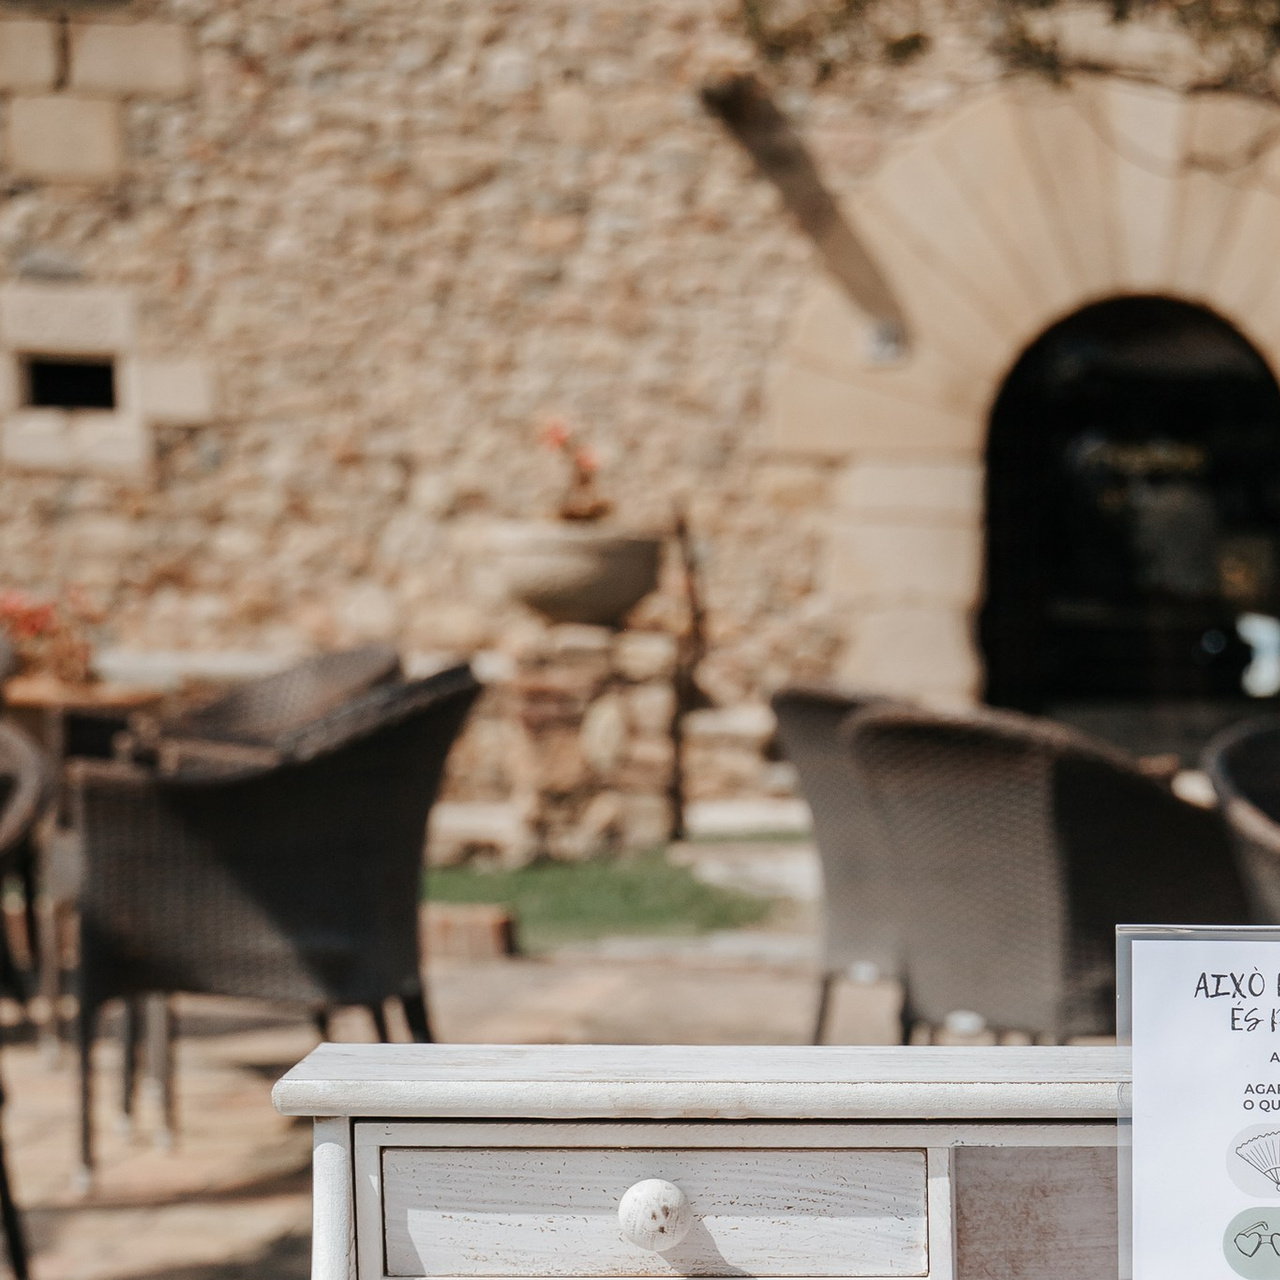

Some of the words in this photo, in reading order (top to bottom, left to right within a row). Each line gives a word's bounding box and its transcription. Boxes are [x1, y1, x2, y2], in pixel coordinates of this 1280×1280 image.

[1194, 966, 1265, 999] AIXÒ
[1231, 1001, 1264, 1032] ÉS
[1243, 1100, 1254, 1110] O
